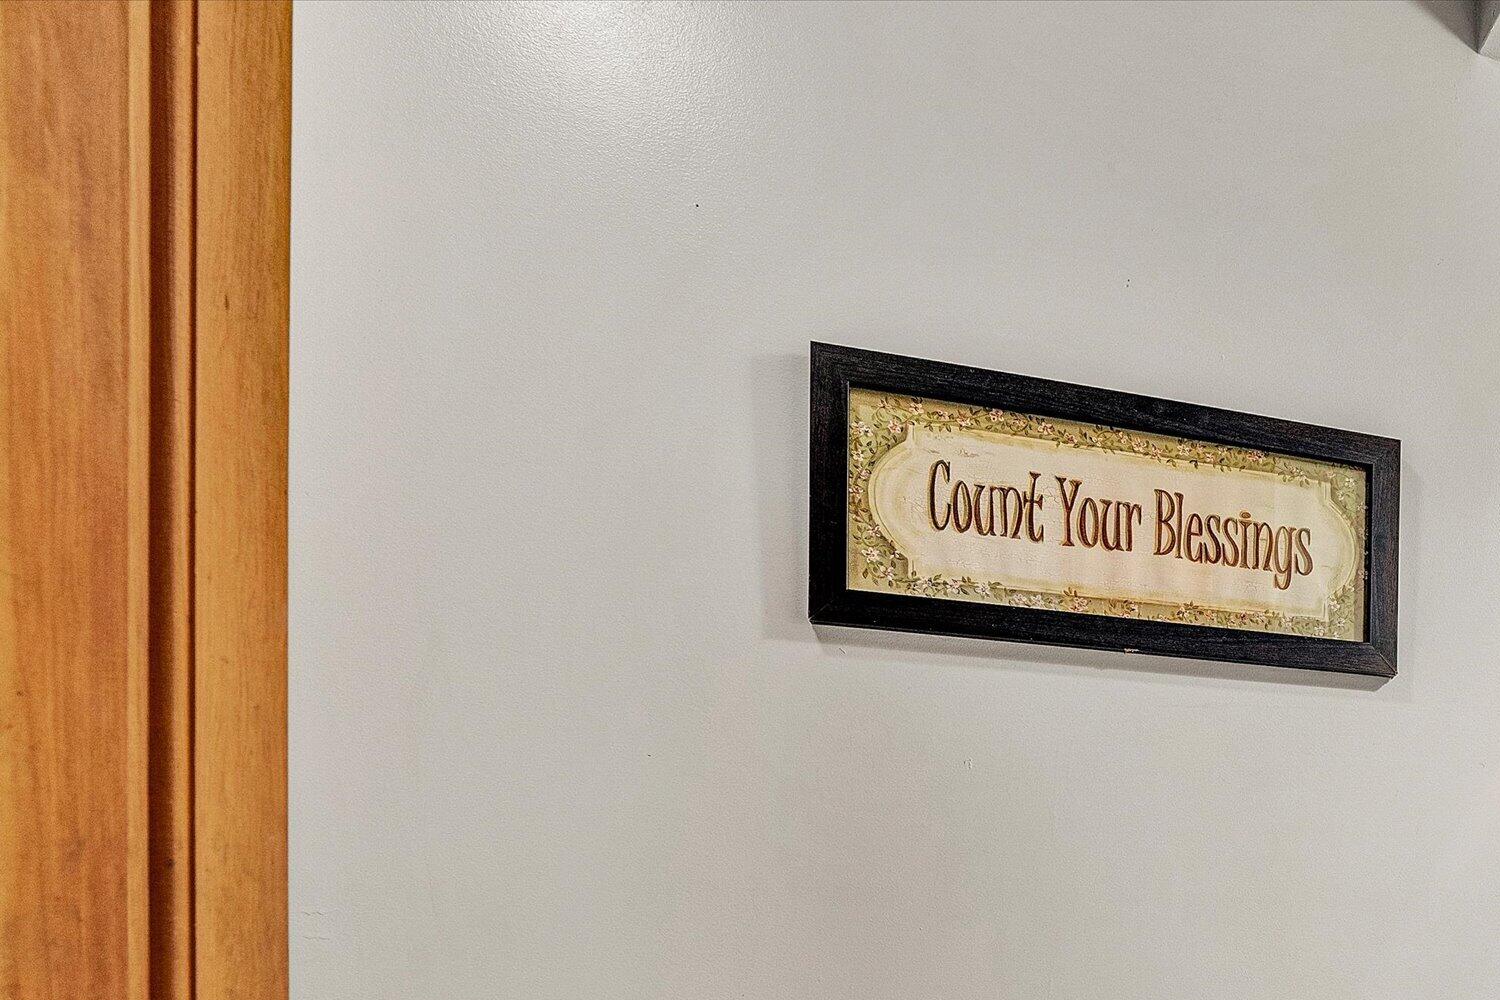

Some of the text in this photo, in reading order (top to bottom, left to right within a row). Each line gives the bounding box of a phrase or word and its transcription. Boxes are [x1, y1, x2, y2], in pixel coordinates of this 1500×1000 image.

[928, 459, 1313, 590] Count Your Blessings
